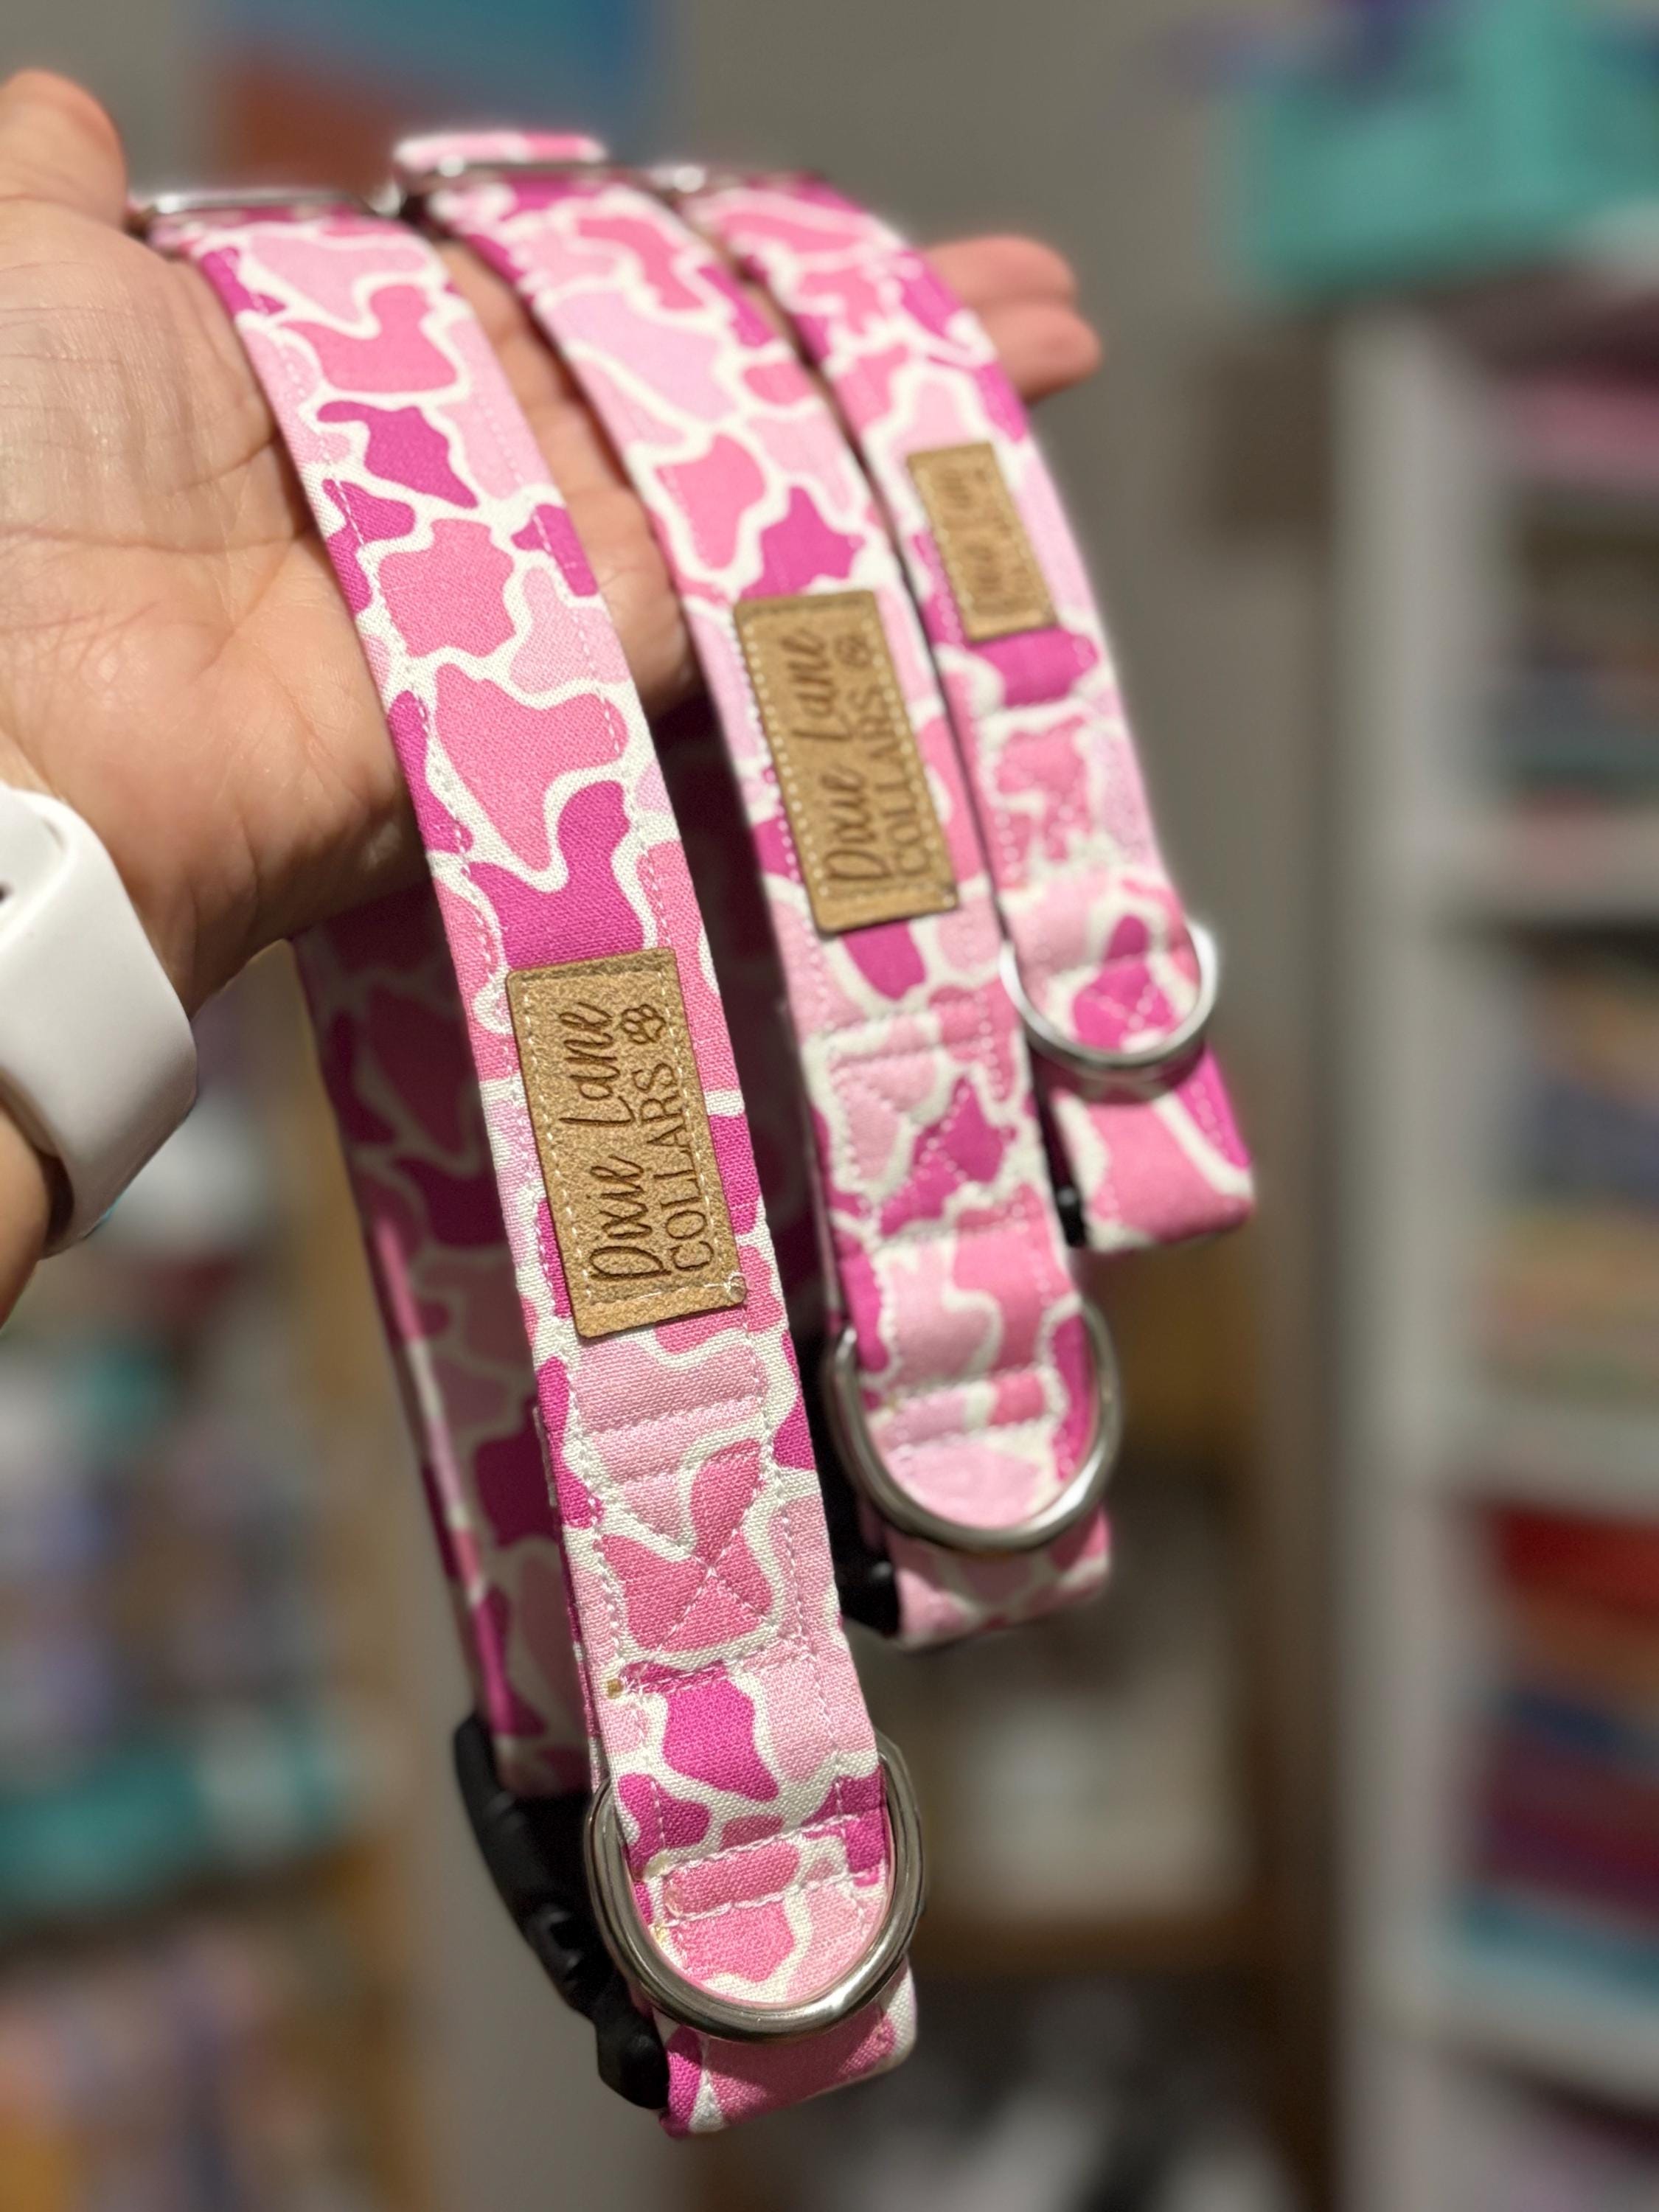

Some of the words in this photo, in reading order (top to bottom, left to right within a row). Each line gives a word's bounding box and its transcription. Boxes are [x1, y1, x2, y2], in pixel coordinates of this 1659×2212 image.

[779, 628, 853, 741] Lane
[817, 764, 892, 880] Dixie
[848, 684, 931, 876] COLLARS
[558, 1001, 634, 1126] Lane
[588, 1154, 672, 1281] Dixie
[633, 1062, 715, 1272] COLLARS
